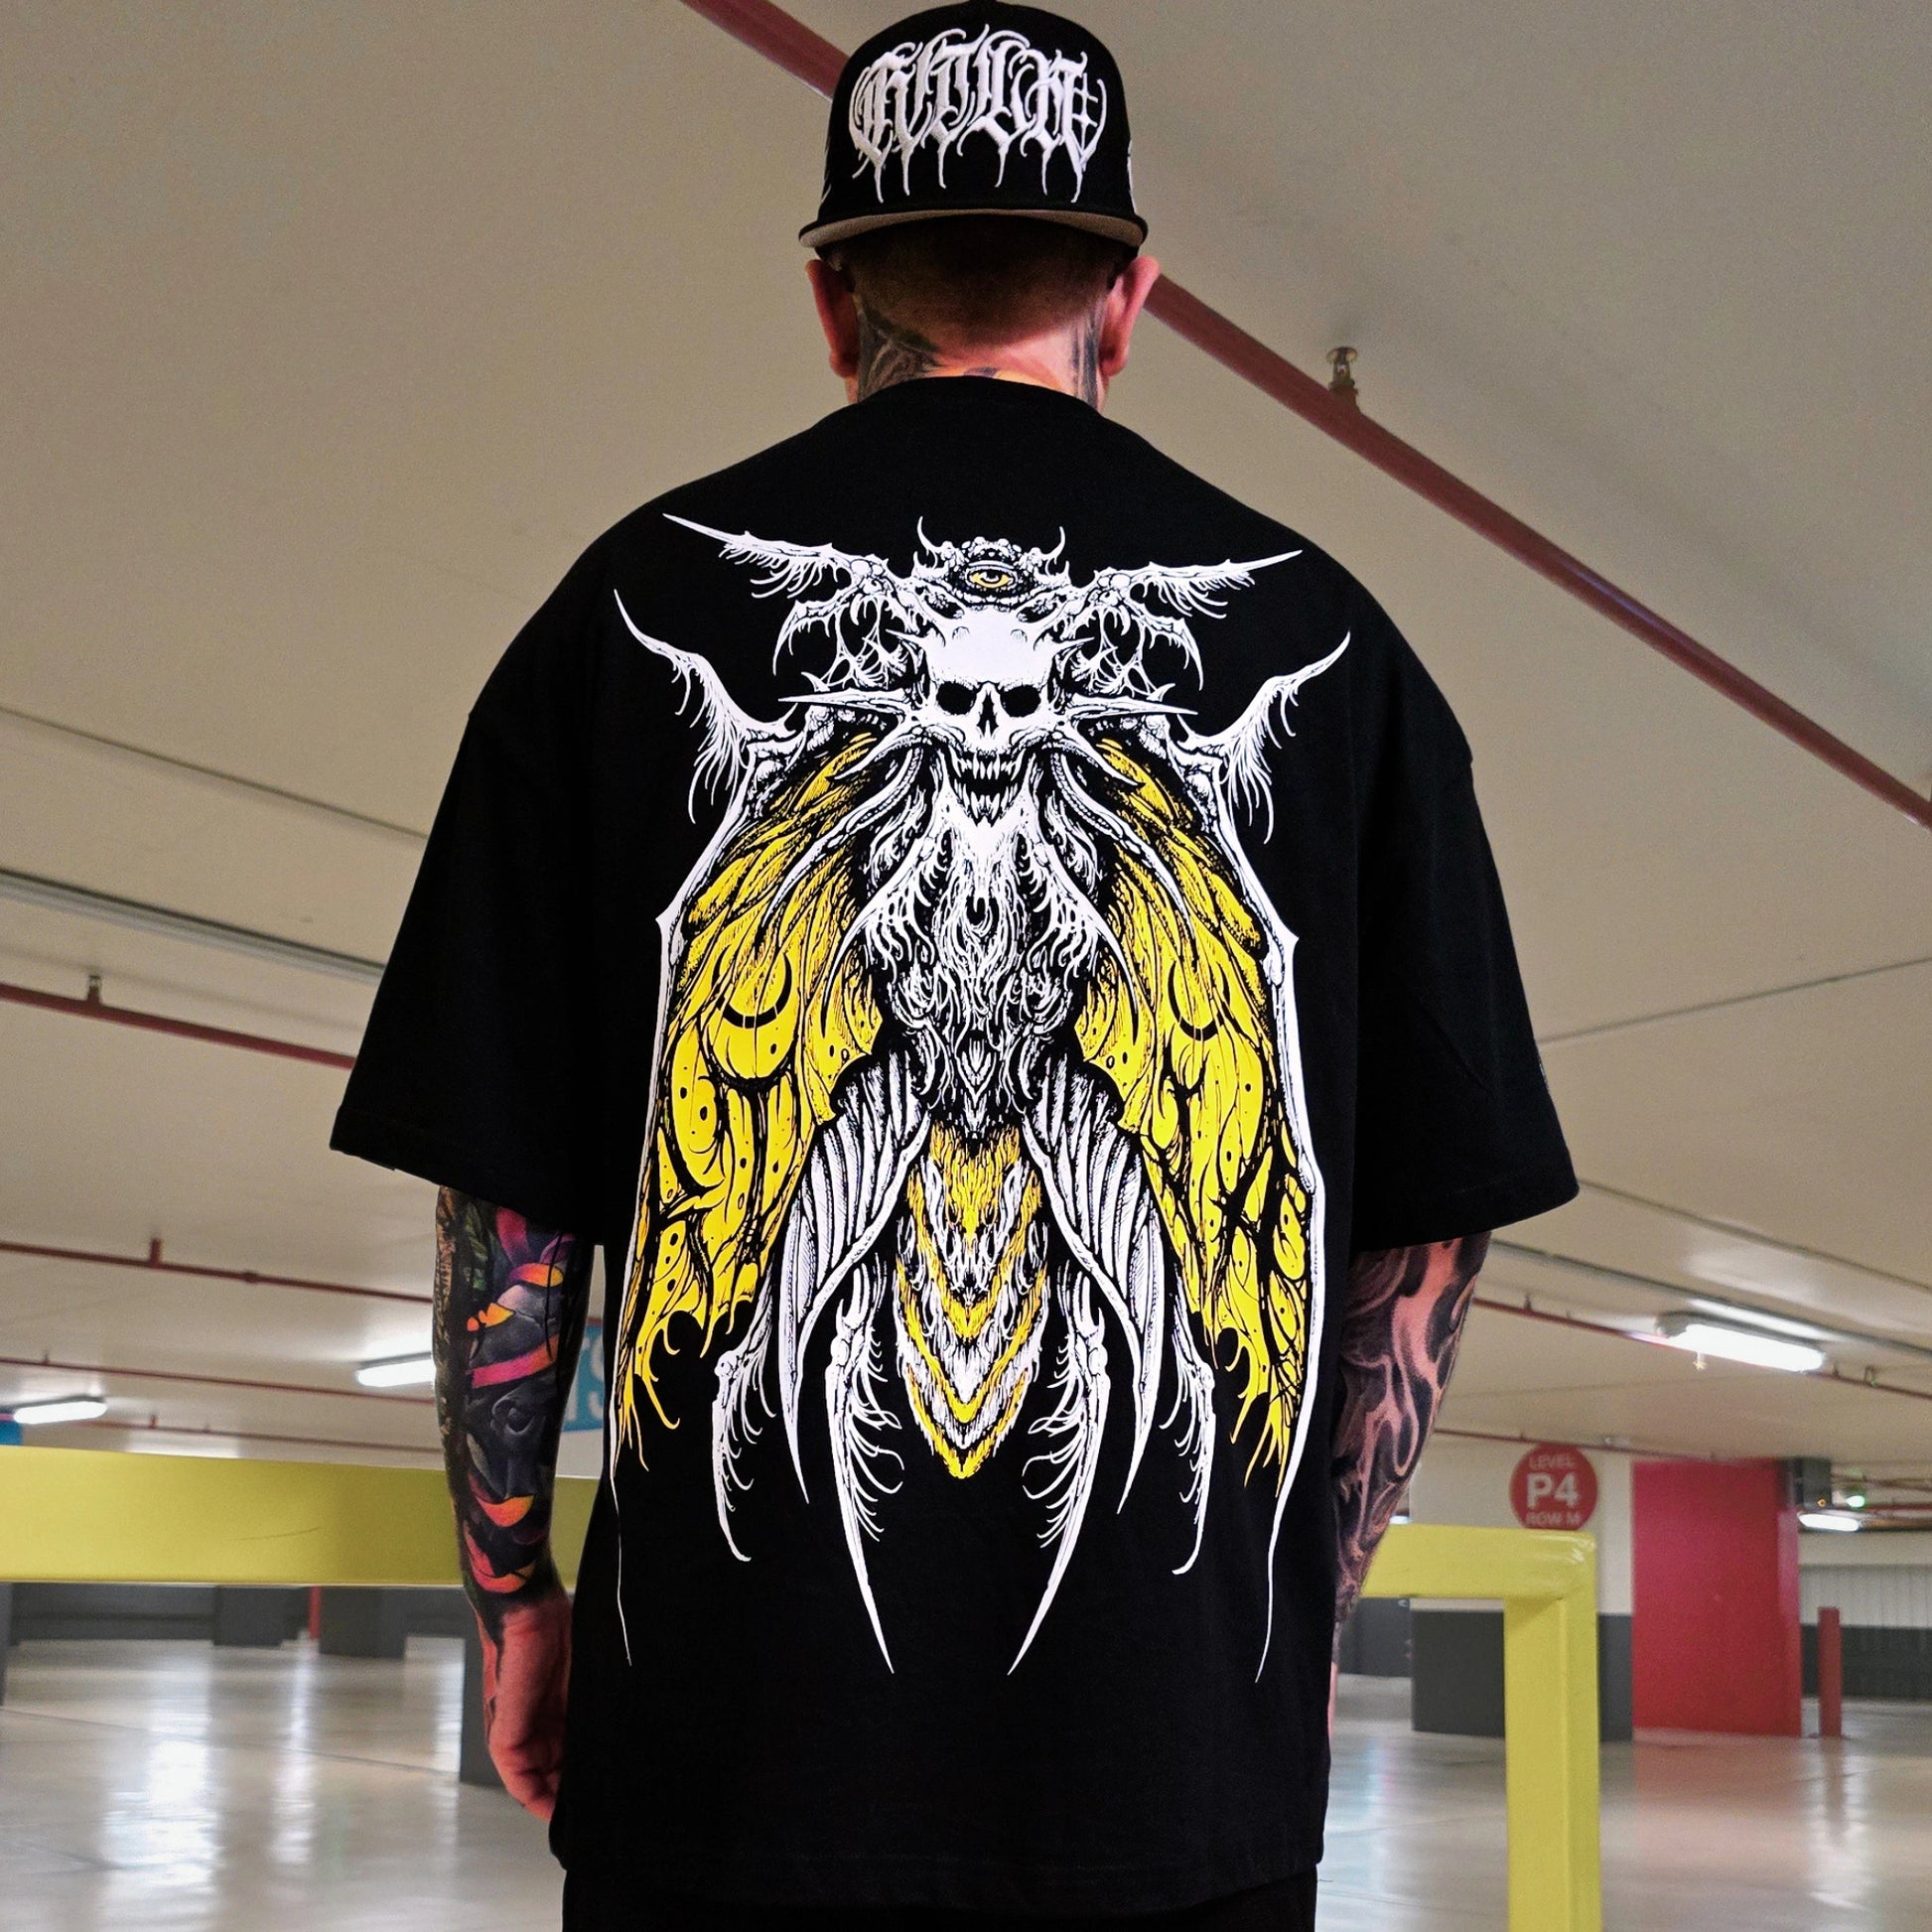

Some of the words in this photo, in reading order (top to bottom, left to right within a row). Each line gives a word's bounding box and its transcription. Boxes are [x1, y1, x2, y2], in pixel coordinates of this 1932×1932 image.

[1529, 1453, 1576, 1469] LEVEL
[1527, 1472, 1580, 1509] P4
[1526, 1511, 1562, 1526] ROW
